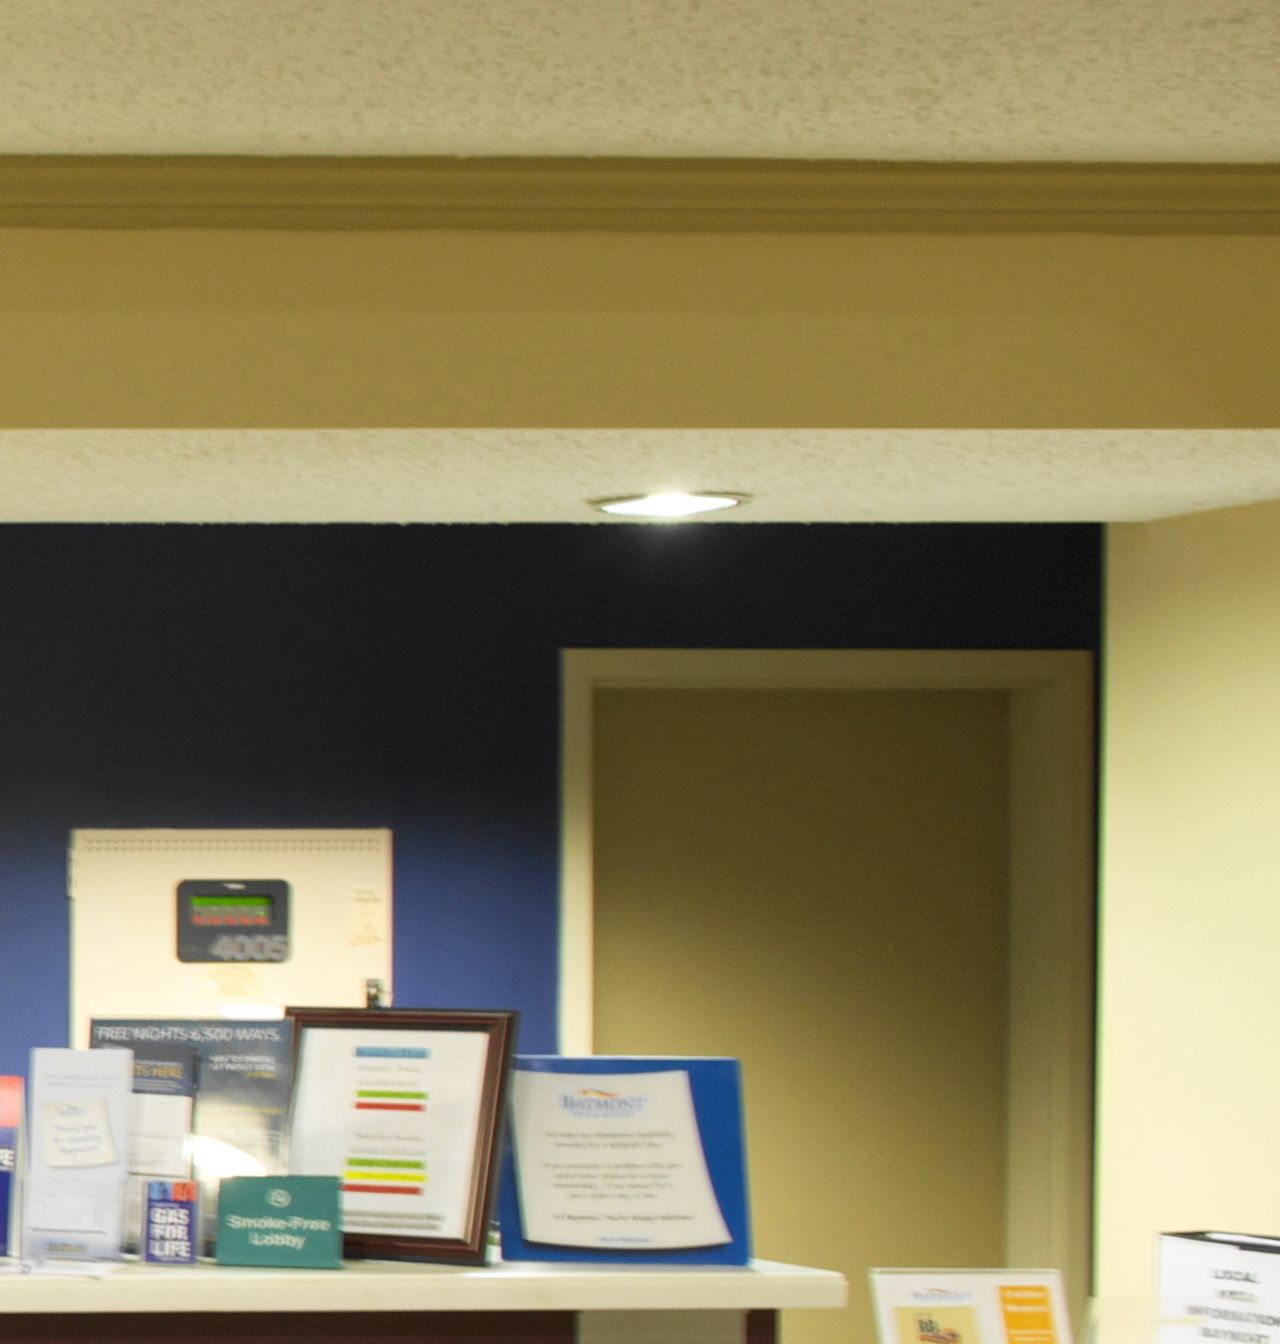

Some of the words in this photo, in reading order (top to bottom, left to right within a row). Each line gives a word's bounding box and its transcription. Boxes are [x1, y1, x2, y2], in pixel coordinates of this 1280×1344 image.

[149, 1207, 190, 1225] GAS
[225, 1215, 332, 1232] Smoke-Free
[150, 1224, 189, 1240] FOR
[149, 1240, 191, 1257] LIFE
[249, 1232, 307, 1250] Lobby
